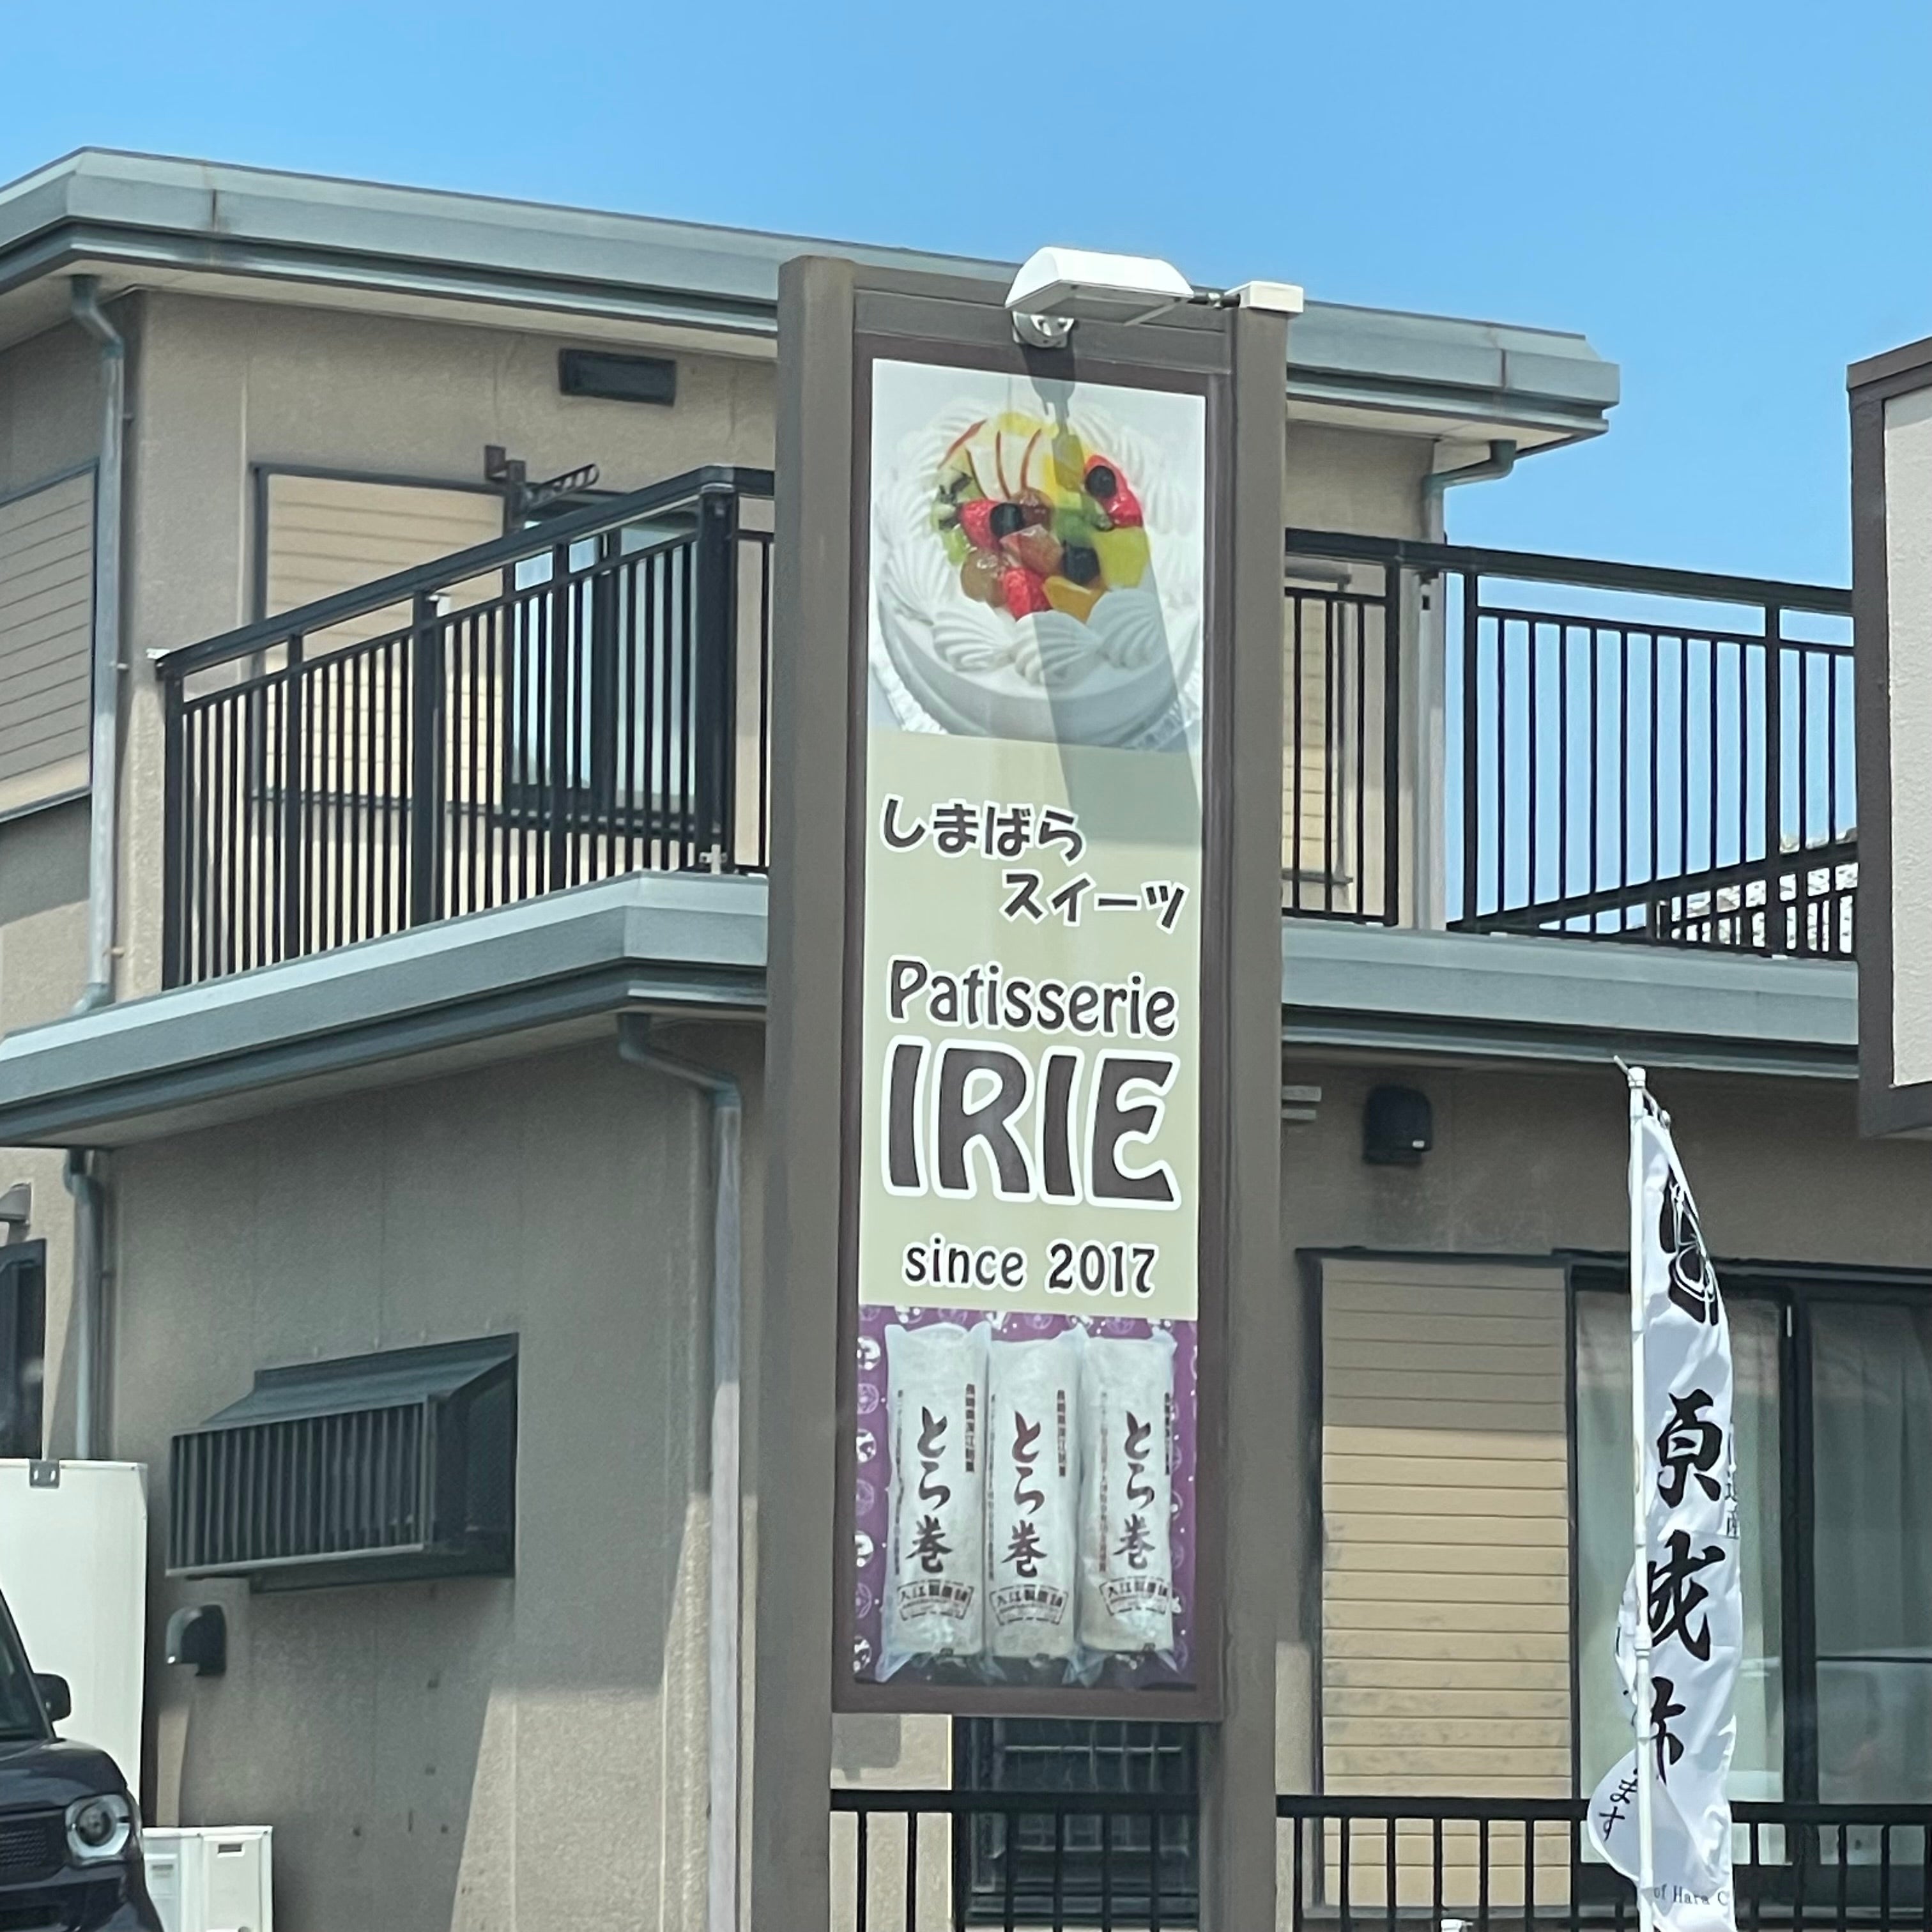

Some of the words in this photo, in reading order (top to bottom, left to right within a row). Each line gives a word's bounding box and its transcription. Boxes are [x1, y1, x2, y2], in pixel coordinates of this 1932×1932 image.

[884, 797, 1084, 862] しまばら
[1003, 873, 1186, 930] スイーツ
[890, 959, 1176, 1038] Patisserie
[887, 1043, 1176, 1203] IRIE
[905, 1237, 1024, 1287] since
[1048, 1243, 1156, 1293] 2017
[905, 1406, 953, 1574] とら巻
[1001, 1411, 1048, 1578] とら巻
[1113, 1411, 1156, 1570] とら巻
[1599, 1767, 1638, 1841] ます
[1673, 1885, 1710, 1905] Hara
